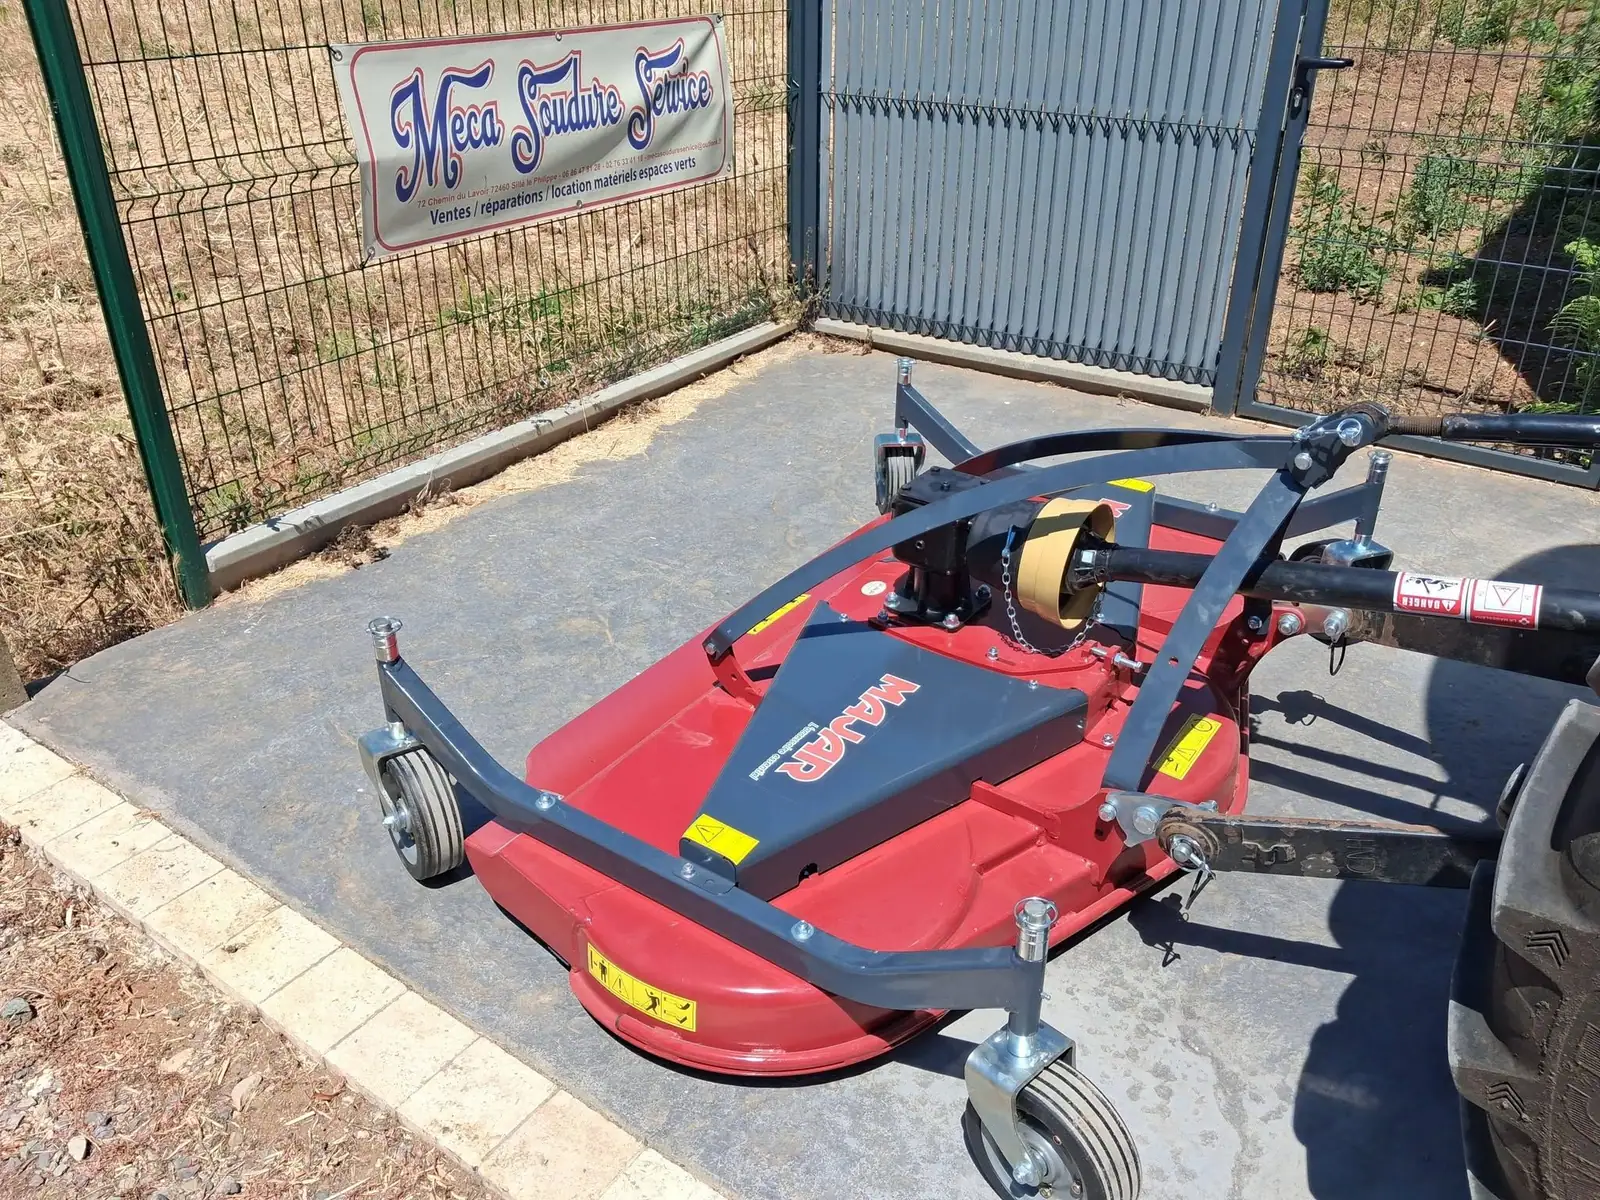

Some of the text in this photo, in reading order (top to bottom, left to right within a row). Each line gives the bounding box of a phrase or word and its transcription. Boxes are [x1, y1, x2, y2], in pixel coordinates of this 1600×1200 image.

[389, 37, 714, 203] Meca Soudure Service
[417, 200, 427, 209] 72
[427, 195, 456, 206] Chemin
[456, 191, 466, 200] du
[467, 188, 489, 198] Lavoir
[490, 183, 510, 194] 72460
[526, 178, 533, 187] le
[533, 173, 558, 186] Philippe
[605, 160, 613, 169] 02
[613, 158, 621, 167] 76
[621, 157, 629, 166] 33
[430, 204, 471, 225] Ventes
[480, 189, 543, 217] réparations
[551, 179, 592, 199] location
[595, 168, 638, 190] matériels
[639, 160, 673, 181] espaces
[674, 156, 696, 171] verts
[1402, 596, 1441, 611] DANGER
[774, 673, 921, 782] MAJAR
